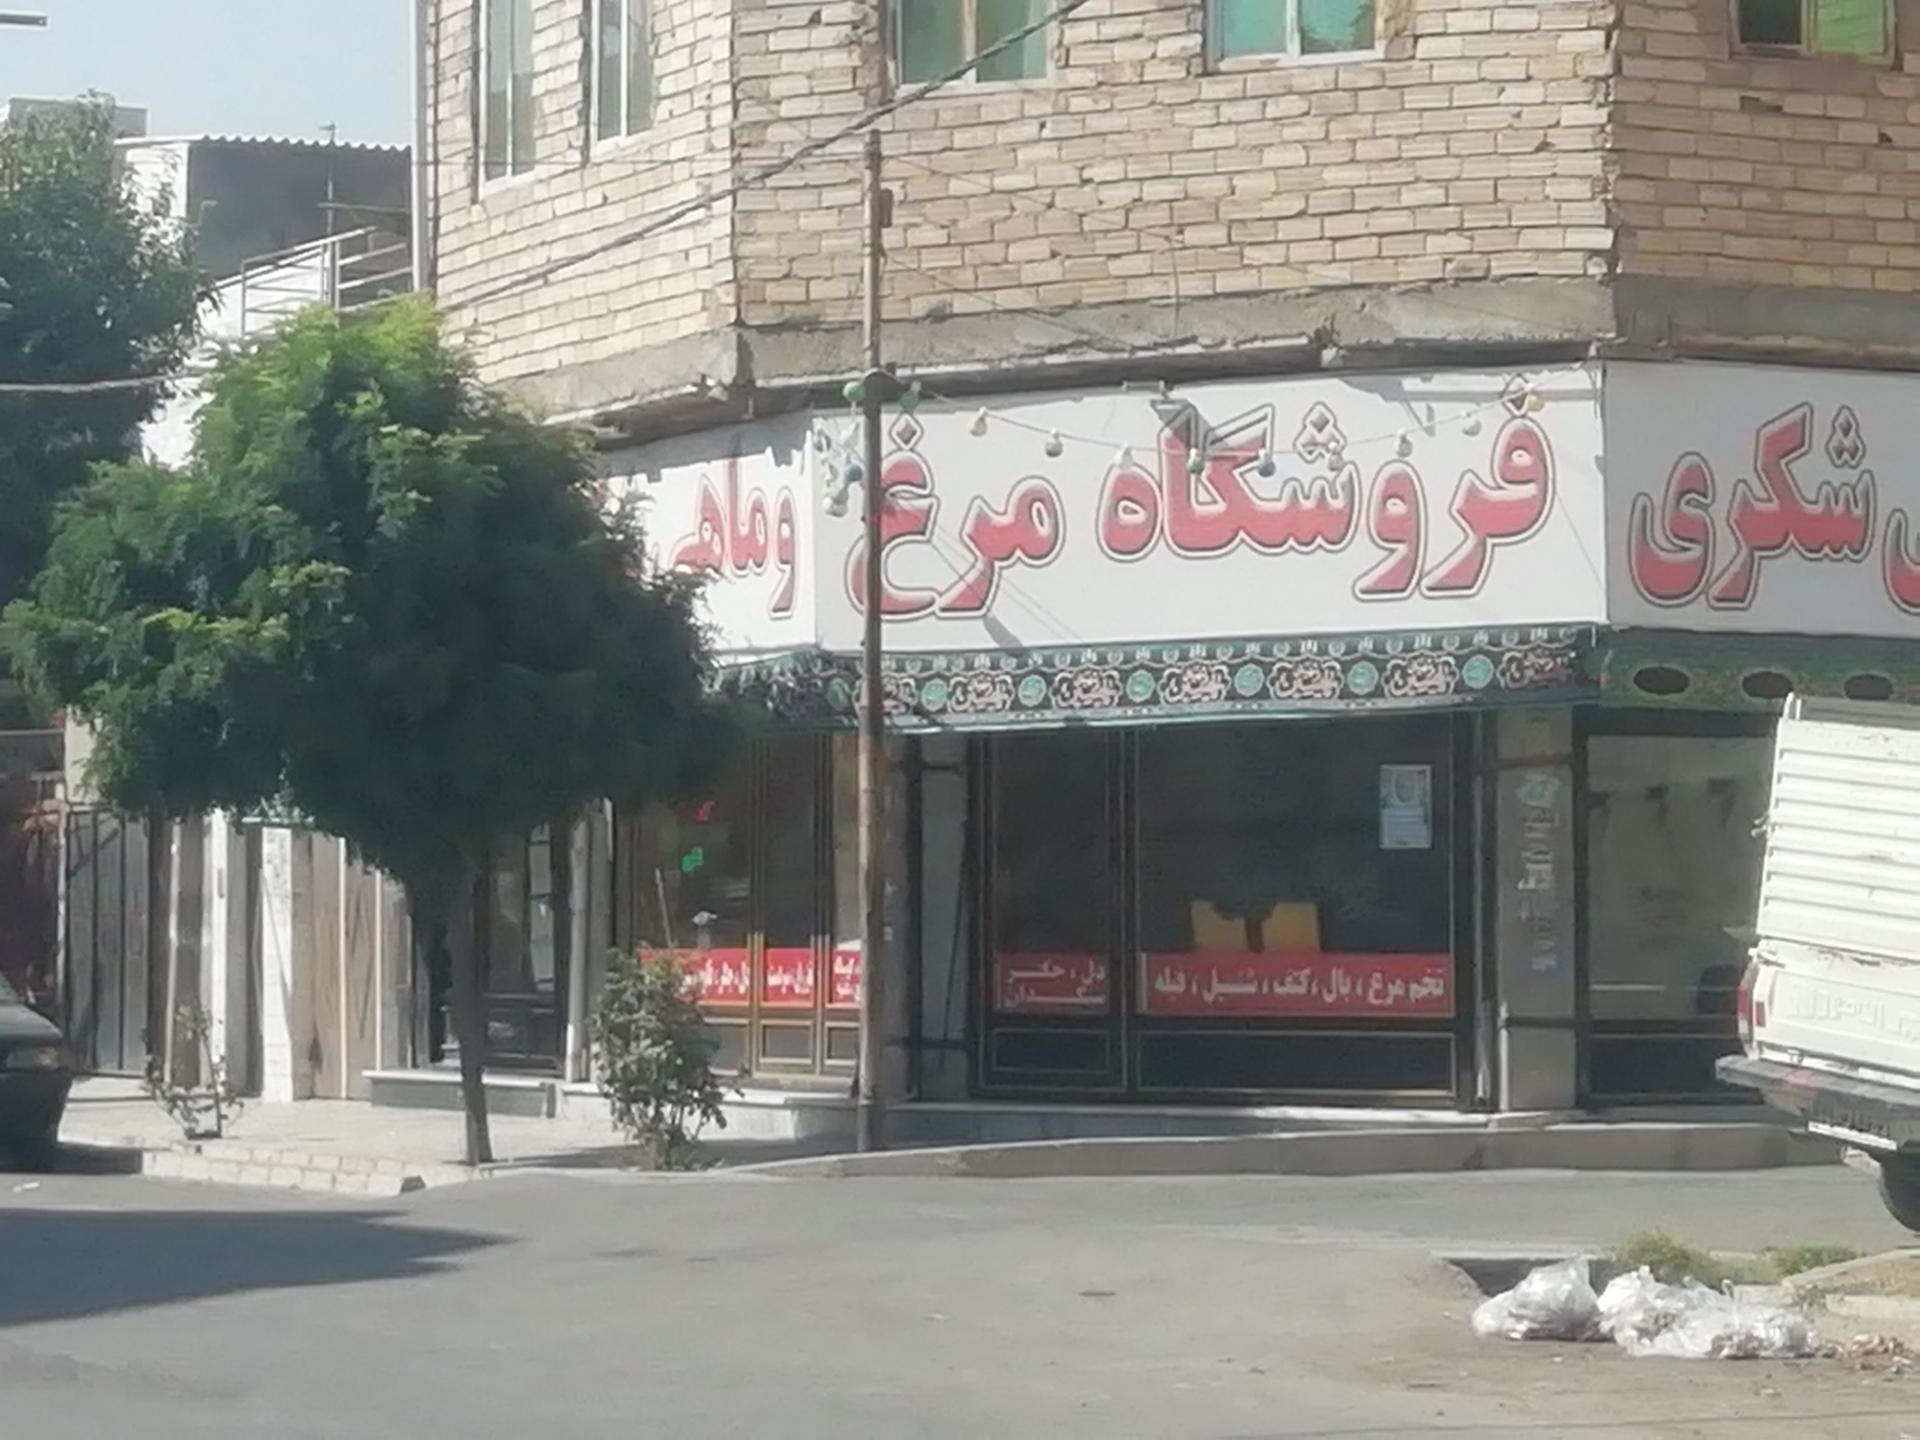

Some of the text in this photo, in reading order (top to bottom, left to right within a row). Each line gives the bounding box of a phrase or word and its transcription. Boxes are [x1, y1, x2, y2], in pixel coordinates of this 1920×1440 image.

[845, 410, 1066, 621] مرغ
[1096, 373, 1557, 600] فروشگاه
[1628, 401, 1877, 609] شکری
[1409, 967, 1446, 1003] تخم
